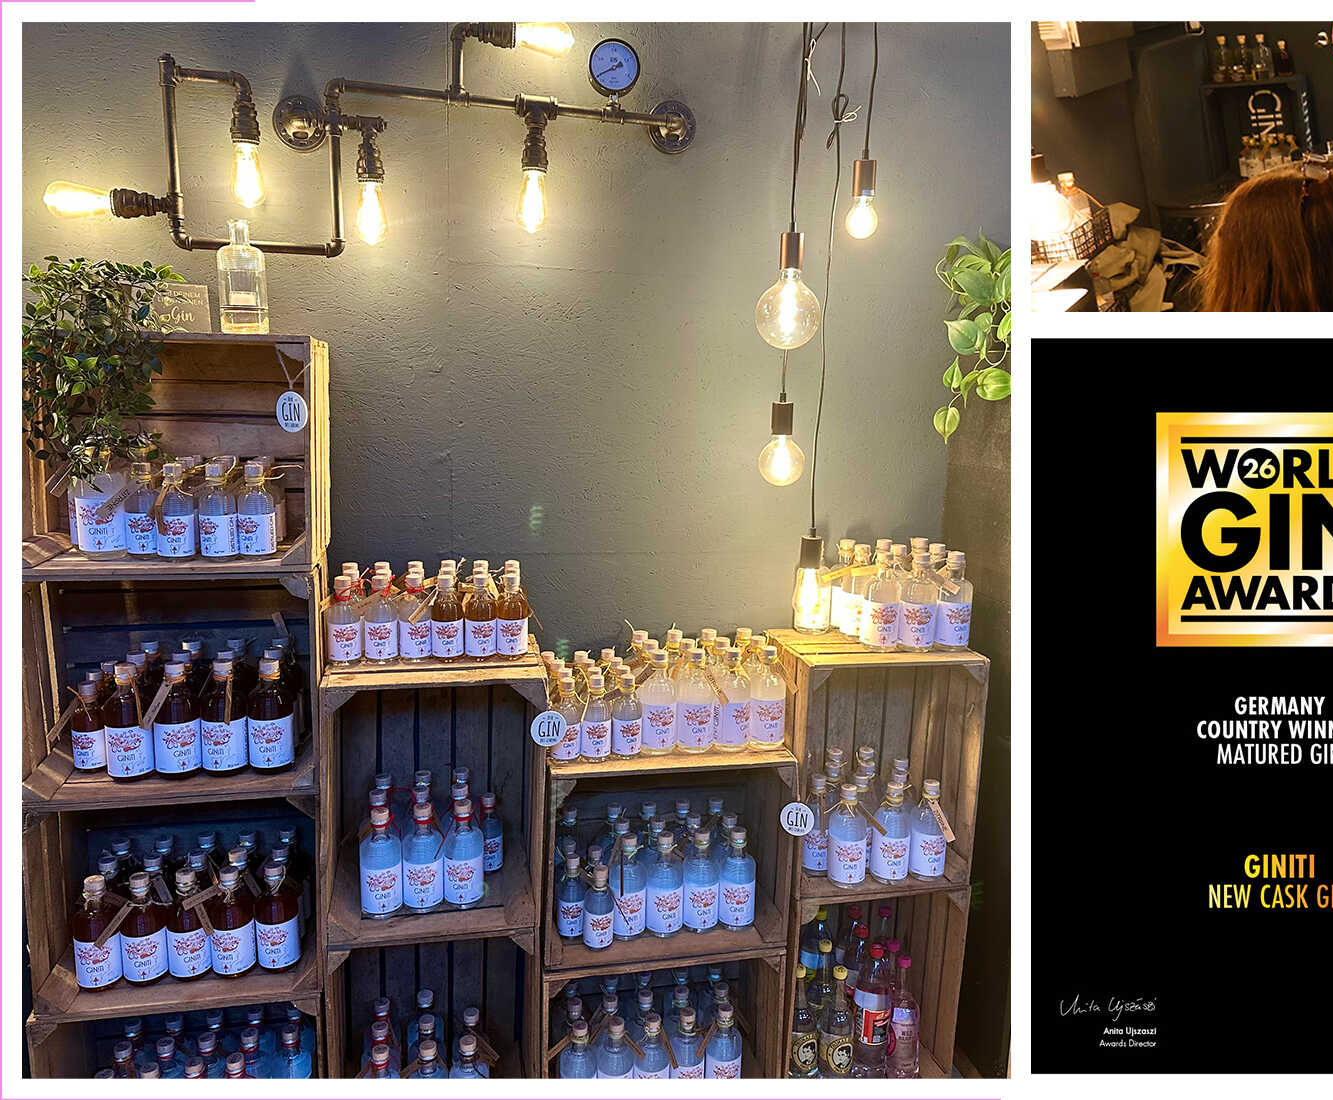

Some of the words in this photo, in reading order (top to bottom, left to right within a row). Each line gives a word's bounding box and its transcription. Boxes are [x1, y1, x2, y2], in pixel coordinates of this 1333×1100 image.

[282, 402, 300, 421] GIN
[1235, 696, 1325, 715] GERMANY
[538, 721, 560, 737] GIN
[1197, 720, 1282, 739] COUNTRY
[1217, 744, 1302, 764] MATURED
[787, 811, 808, 828] GIN
[1244, 854, 1315, 878] GINITI
[1209, 884, 1251, 908] NEW
[1260, 884, 1308, 908] CASK
[1103, 1027, 1123, 1035] Anita
[1099, 1039, 1126, 1047] Awards
[1129, 1039, 1157, 1047] Director
